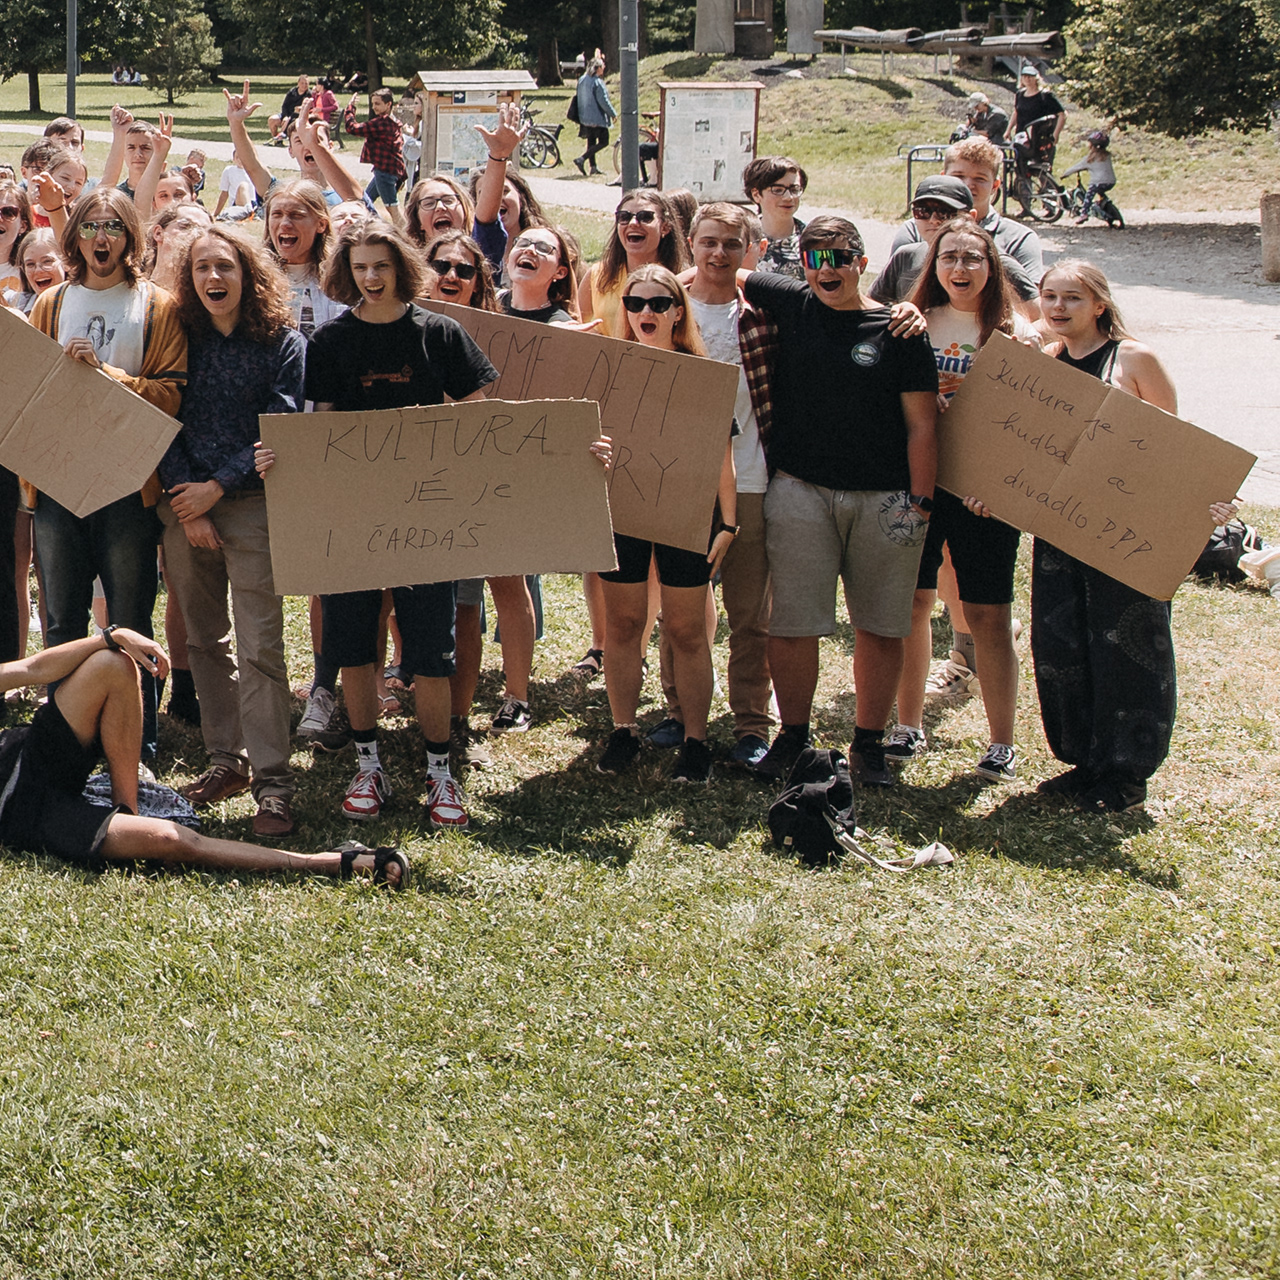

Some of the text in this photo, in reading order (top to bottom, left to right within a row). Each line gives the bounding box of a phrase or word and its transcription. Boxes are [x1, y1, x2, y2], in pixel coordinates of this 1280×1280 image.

[670, 96, 677, 107] 3
[987, 358, 1076, 417] Kultura
[324, 414, 547, 462] KULTURA
[992, 412, 1072, 467] hudba
[1003, 469, 1089, 530] divadlo
[367, 519, 487, 553] ČARDÁŠ
